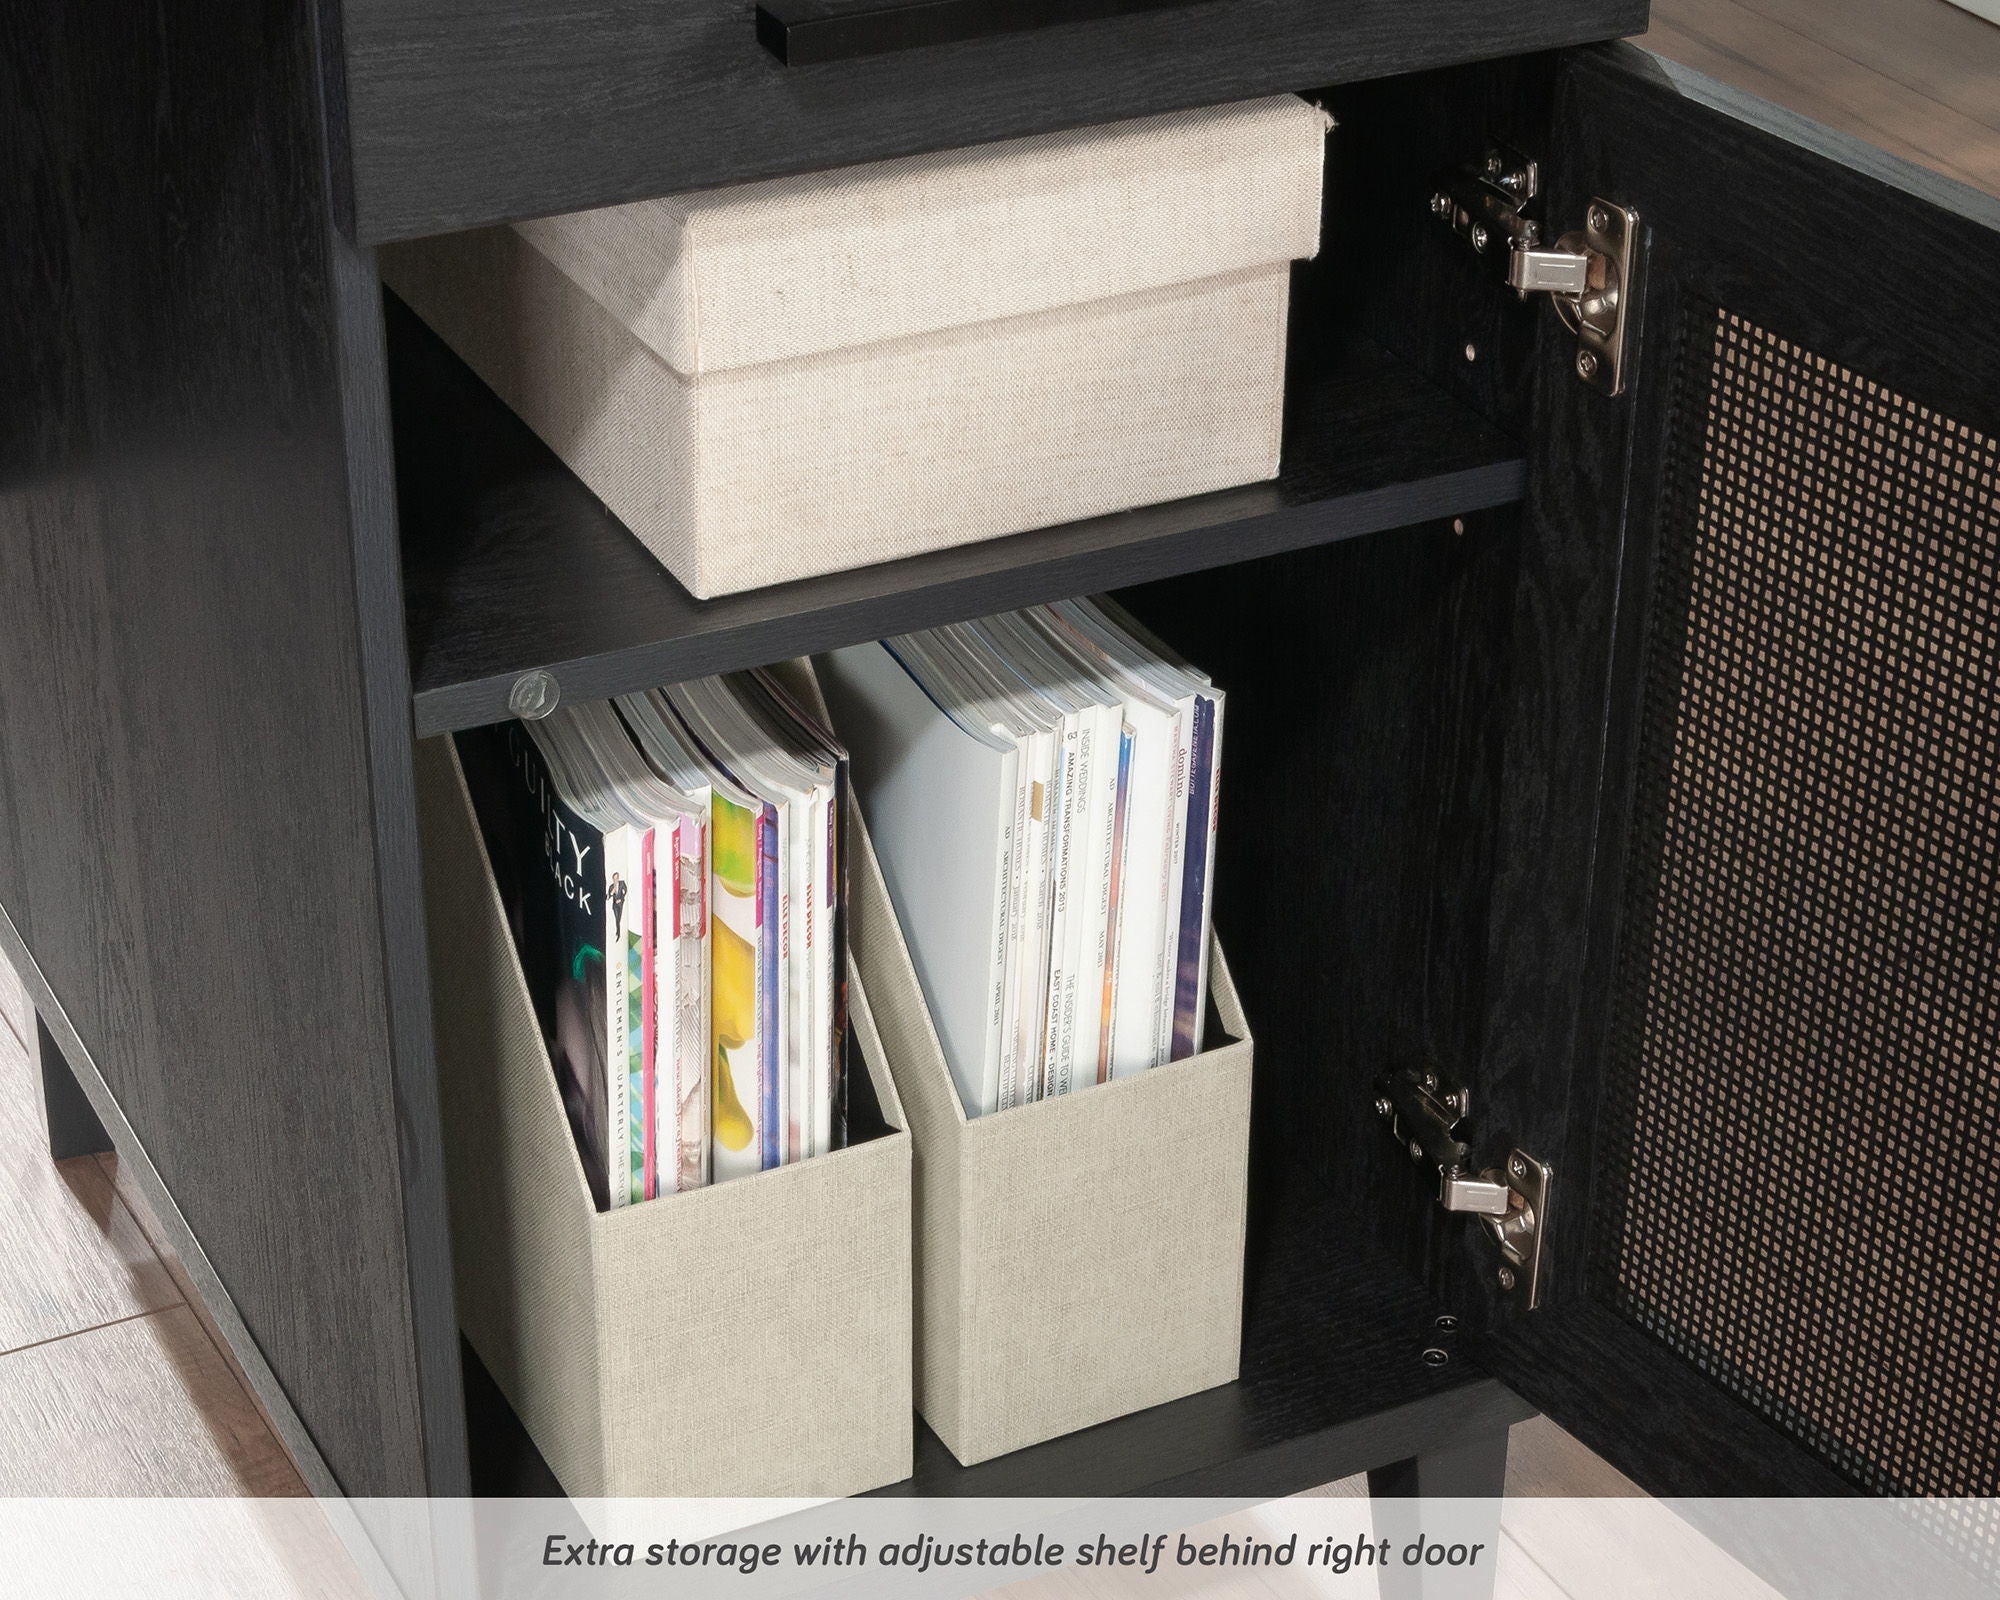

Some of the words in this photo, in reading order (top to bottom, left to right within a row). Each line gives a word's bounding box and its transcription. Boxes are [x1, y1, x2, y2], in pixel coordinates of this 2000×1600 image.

[1080, 728, 1091, 759] INSIDE
[1065, 751, 1076, 796] AMAZING
[1076, 761, 1089, 814] WEDDINGS
[1109, 777, 1115, 790] AD
[1176, 748, 1188, 798] domino
[1059, 797, 1073, 890] TRANSFORMATIONS
[1103, 802, 1114, 879] ARCHITECTURAL
[545, 832, 591, 916] BLACK
[999, 850, 1010, 927] ARCHITECTURAL
[1057, 891, 1066, 913] 2013
[1100, 883, 1108, 916] DIGEST
[996, 931, 1006, 966] DIGEST
[1053, 968, 1062, 991] EAST
[1065, 973, 1075, 990] THE
[615, 962, 624, 1056] GENTLEMEN'S
[1050, 993, 1060, 1025] COAST
[1062, 991, 1074, 1034] INSIDER'S
[1049, 1025, 1058, 1053] HOME
[1060, 1035, 1070, 1062] GUIDE
[1046, 1063, 1056, 1097] DESIGN
[1058, 1077, 1069, 1096] WE
[1059, 1064, 1069, 1077] TO
[616, 1064, 624, 1141] QUARTERLY
[617, 1150, 625, 1169] THE
[617, 1171, 625, 1201] STYLE
